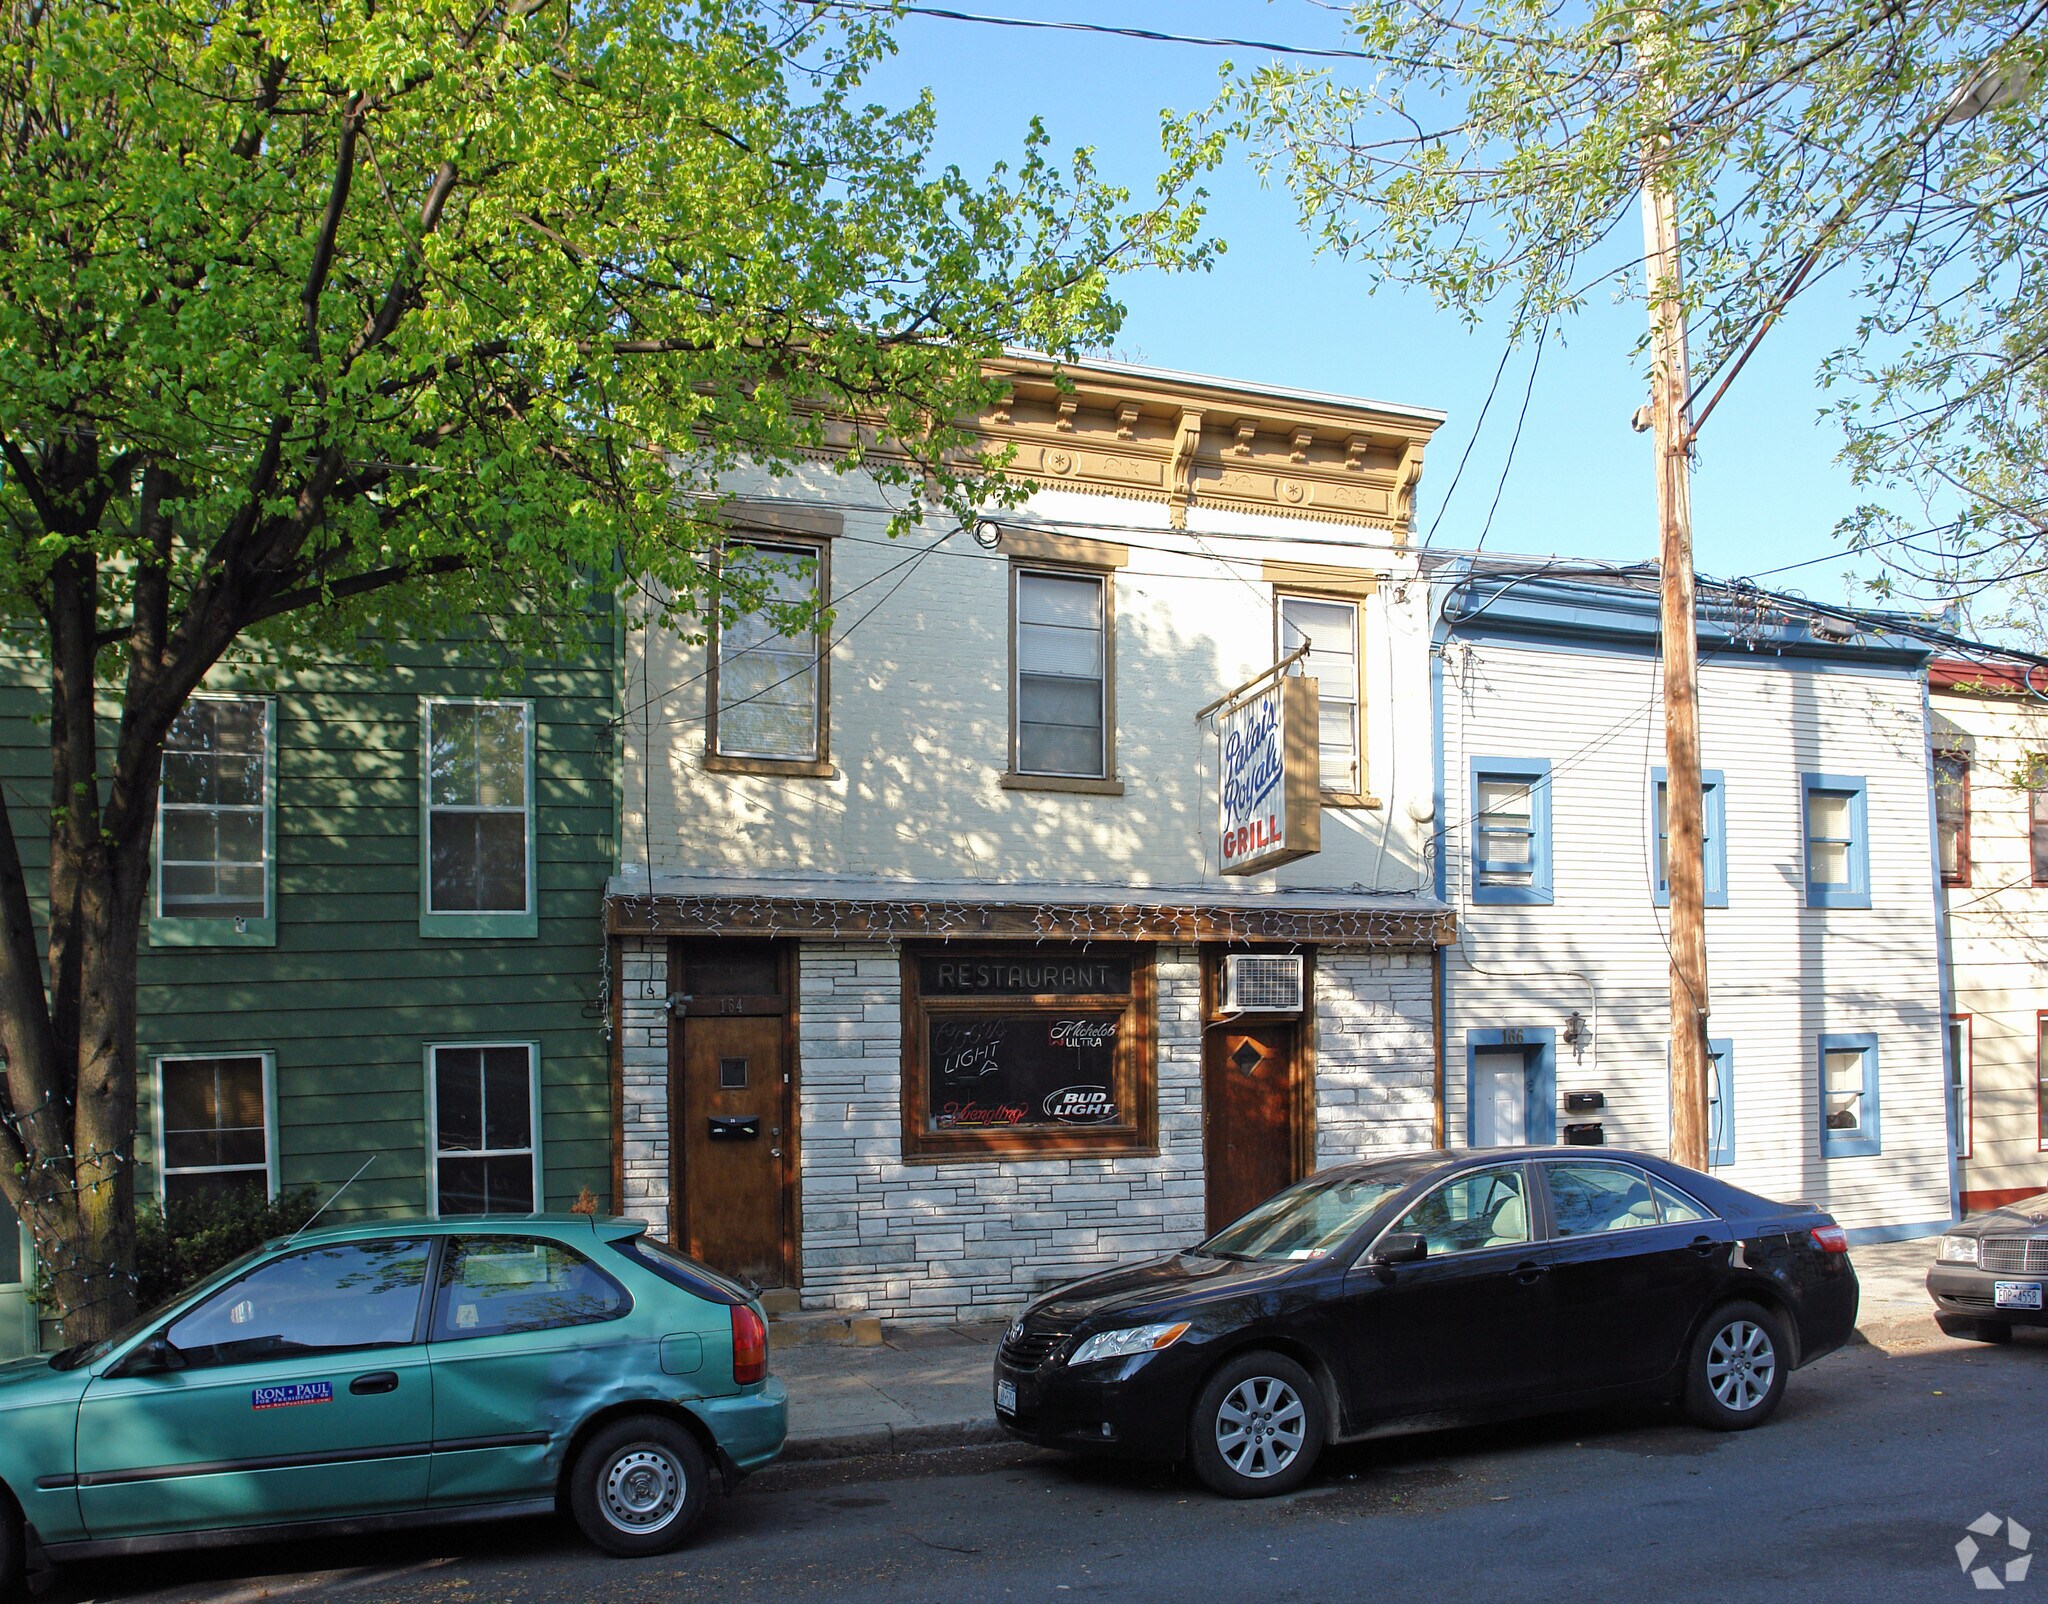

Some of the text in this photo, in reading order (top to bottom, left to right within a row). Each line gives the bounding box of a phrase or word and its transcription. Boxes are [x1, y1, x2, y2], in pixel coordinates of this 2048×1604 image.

[1225, 700, 1278, 782] Palais
[1223, 733, 1283, 832] Royale
[1223, 814, 1282, 859] GRILL
[938, 963, 1110, 988] RESTAURANT
[1050, 1020, 1116, 1039] Michelob
[1502, 1028, 1524, 1044] 166
[1066, 1037, 1102, 1048] ULTRA
[944, 1040, 1000, 1074] LIGHT
[1063, 1092, 1107, 1104] BUD
[943, 1101, 1029, 1126] Yuengling
[1053, 1103, 1115, 1116] LIGHT
[255, 1384, 329, 1401] RON PAUL
[273, 1394, 315, 1403] PRESIDENT
